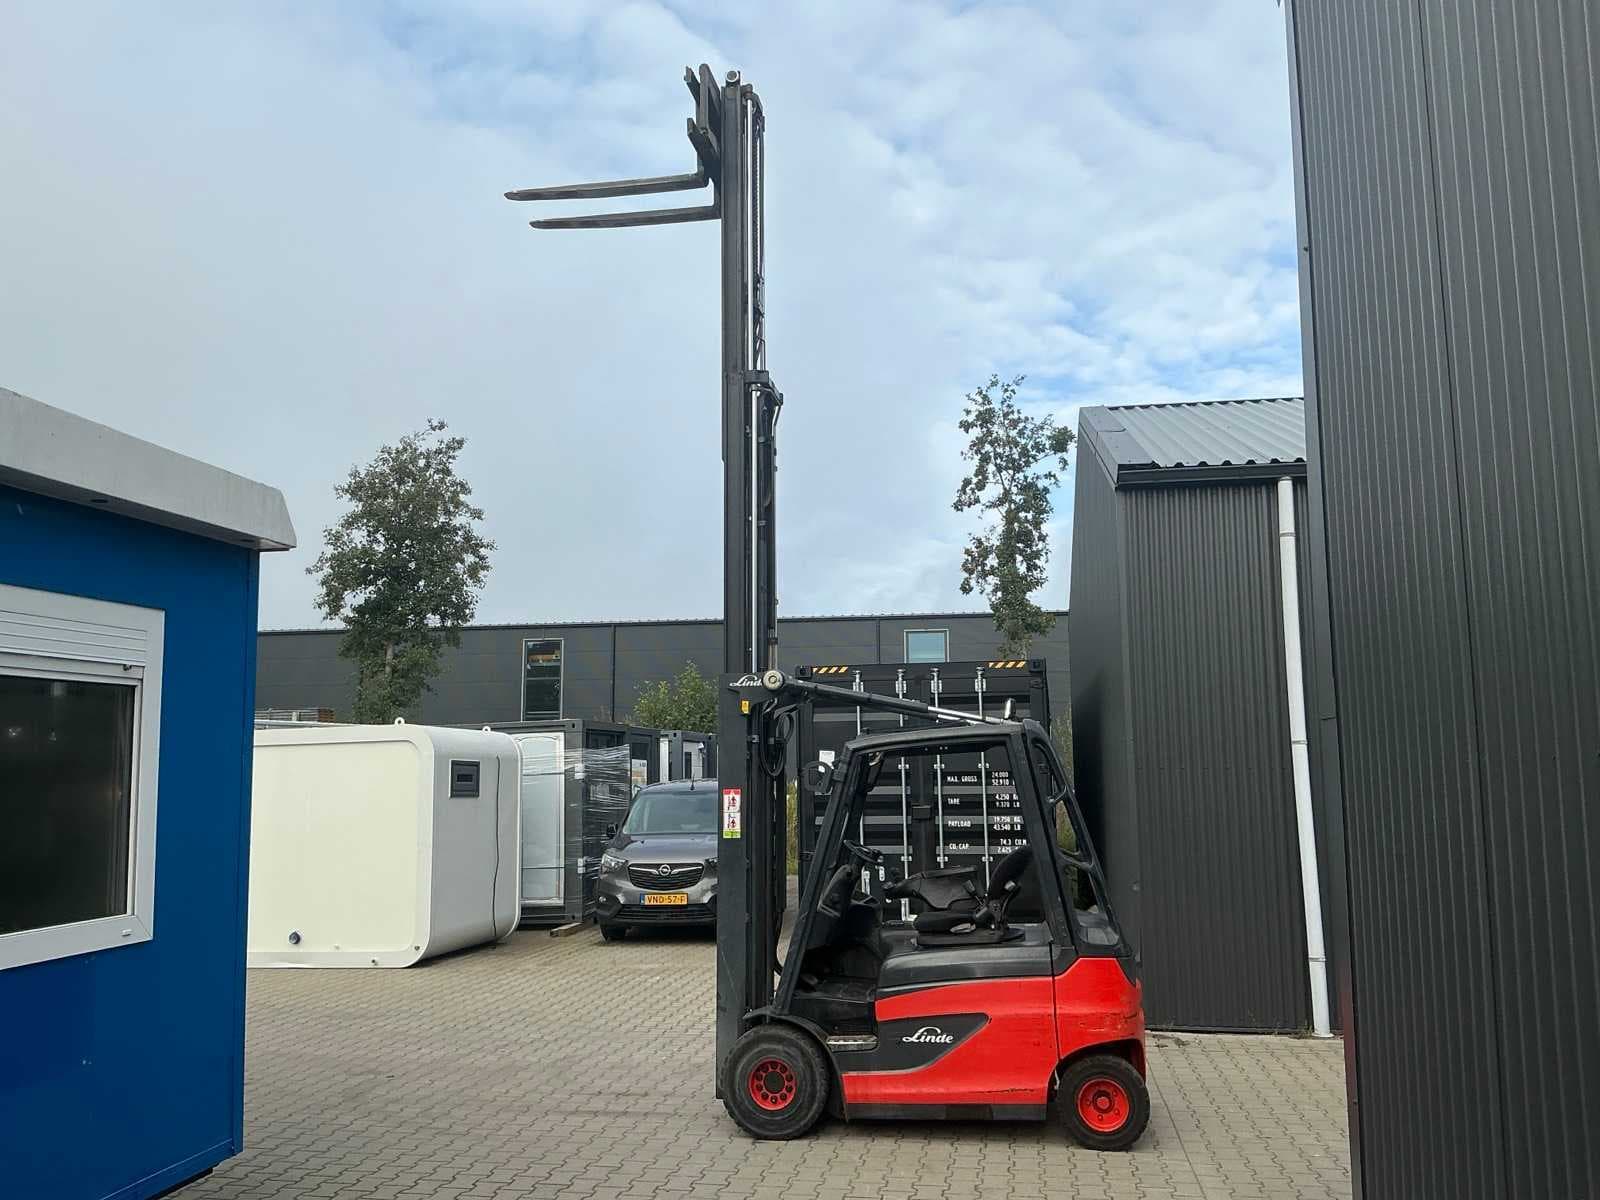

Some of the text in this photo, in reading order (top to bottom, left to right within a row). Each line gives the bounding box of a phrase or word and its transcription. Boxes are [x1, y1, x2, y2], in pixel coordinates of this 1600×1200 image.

[961, 775, 978, 783] GROSS
[947, 820, 972, 828] PAYLOAD
[993, 823, 1011, 831] 43.540
[647, 895, 686, 904] VND-57-F
[902, 1026, 954, 1043] Linde
